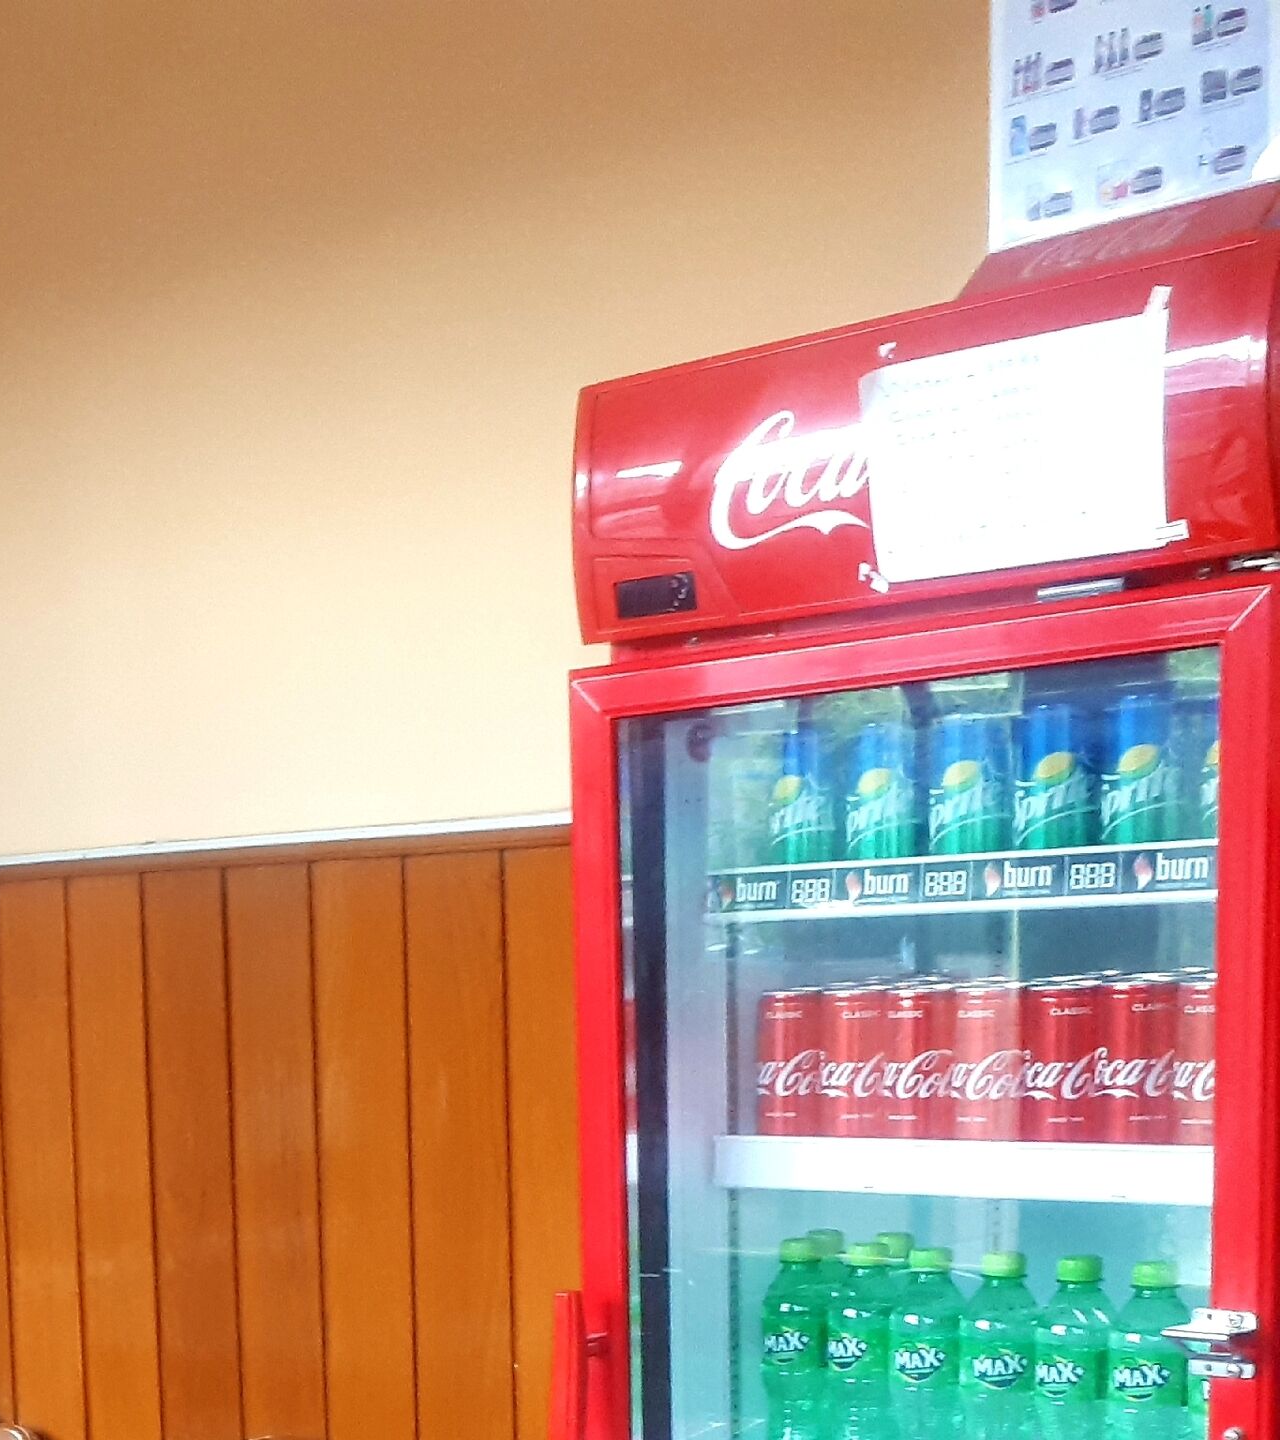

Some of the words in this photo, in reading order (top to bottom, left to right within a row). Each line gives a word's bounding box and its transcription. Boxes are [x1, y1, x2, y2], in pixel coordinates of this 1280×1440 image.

[709, 410, 875, 550] Coca
[736, 878, 776, 902] burn
[864, 869, 909, 895] burn
[1003, 861, 1054, 888] burn
[1156, 852, 1208, 881] burn
